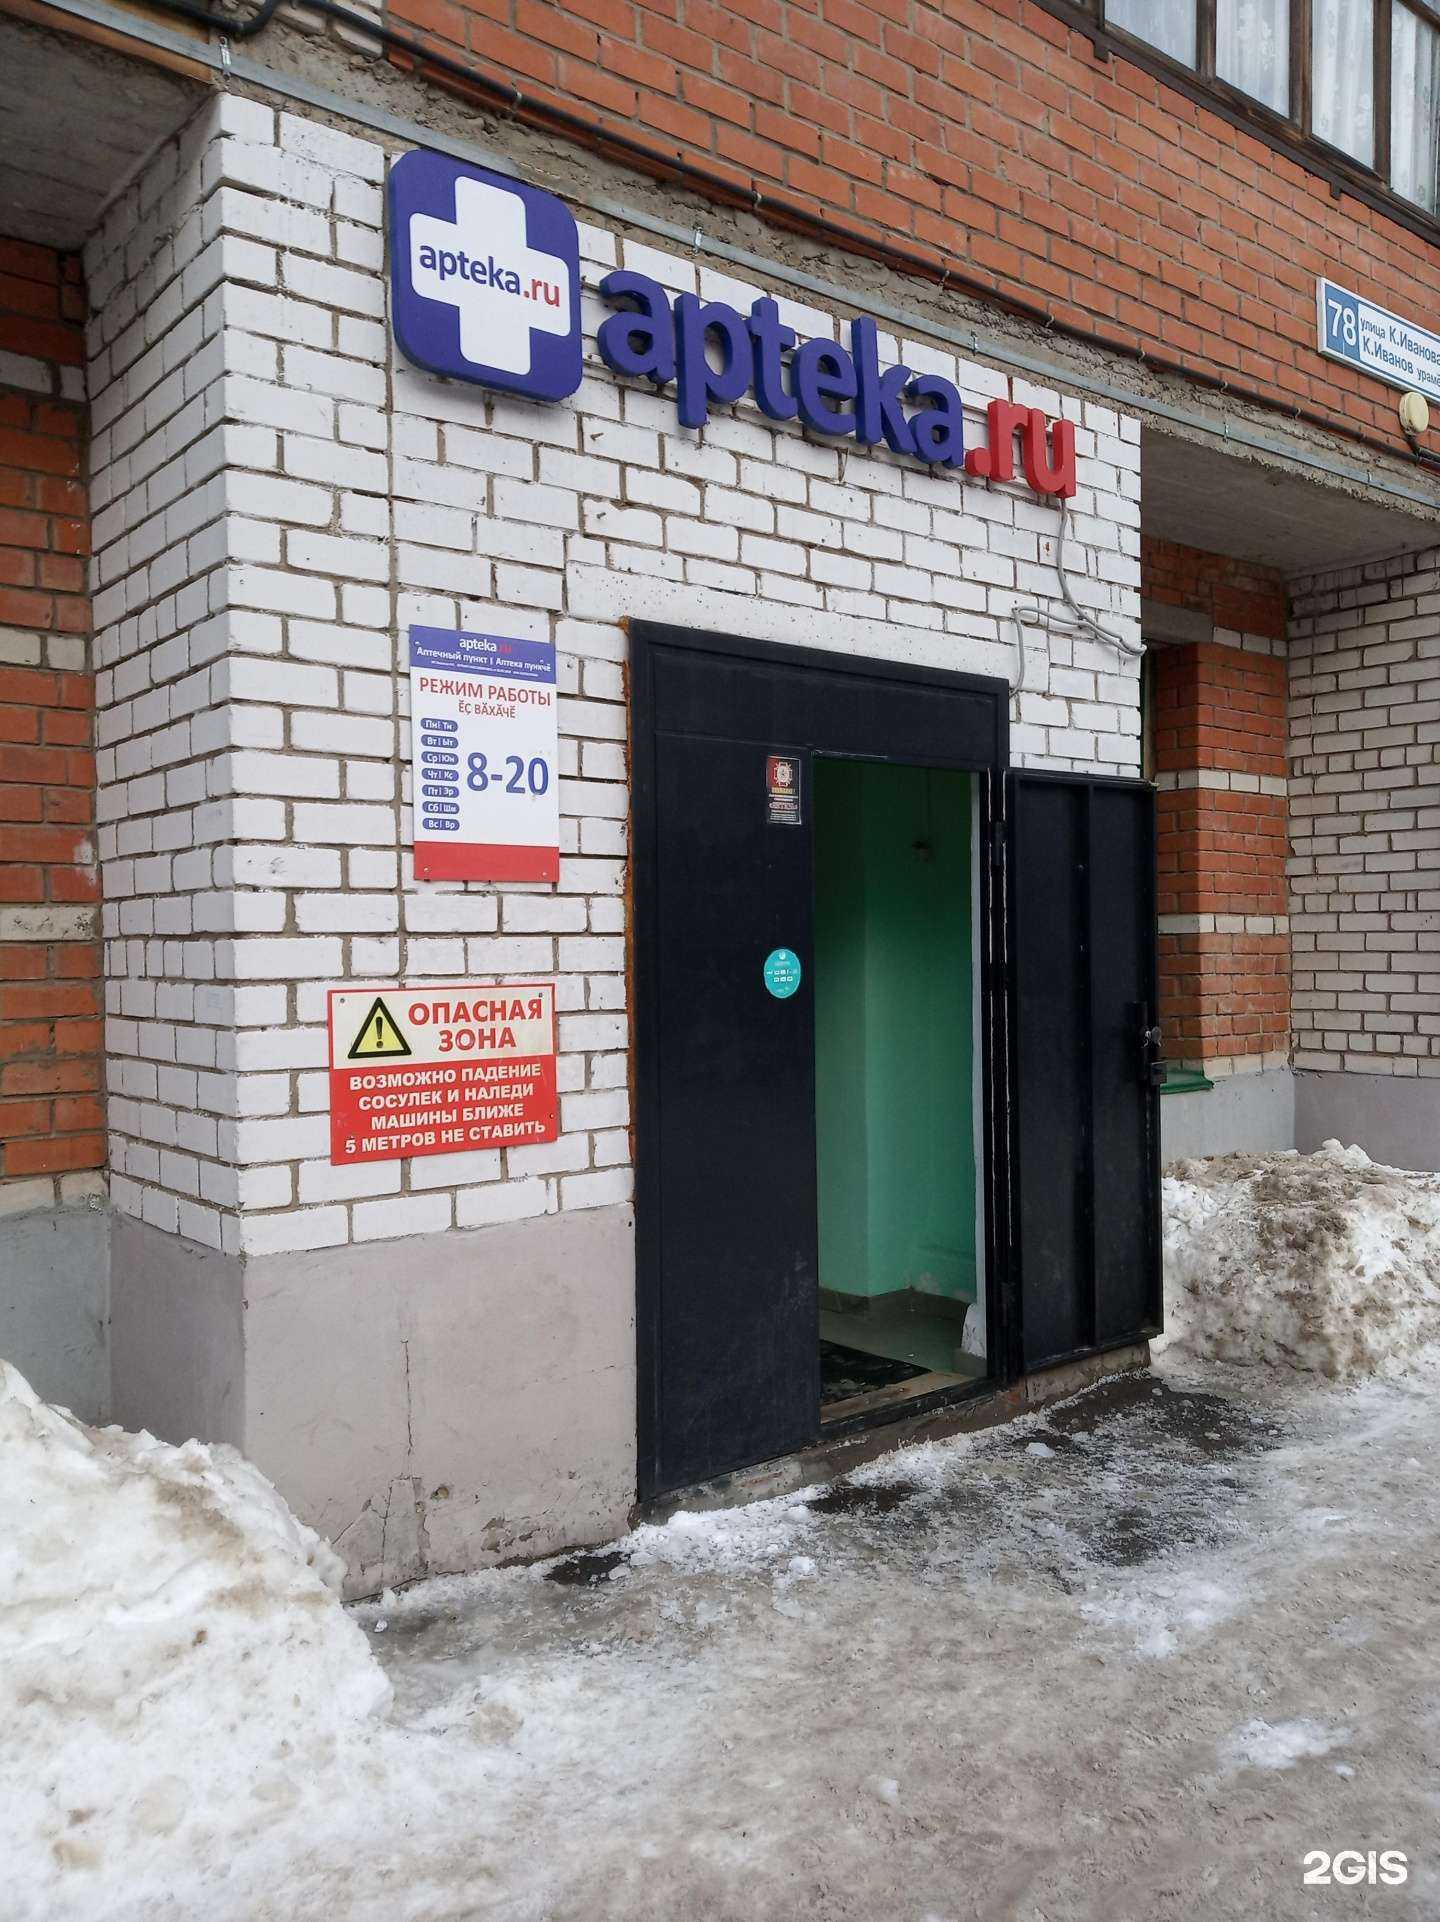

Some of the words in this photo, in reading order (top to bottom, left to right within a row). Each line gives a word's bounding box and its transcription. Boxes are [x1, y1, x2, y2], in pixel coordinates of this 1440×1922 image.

[420, 245, 559, 306] apteka.ru
[1327, 298, 1358, 346] 78
[1360, 317, 1386, 339] улица
[1363, 335, 1414, 374] К.Иванов
[597, 270, 1077, 498] apteka.ru
[416, 646, 461, 660] Аптечный
[463, 654, 488, 664] пункт
[495, 657, 523, 668] Аптека
[419, 677, 483, 698] РЕЖИМ
[488, 685, 551, 706] РАБОТЫ
[467, 752, 549, 796] 8-20
[408, 998, 543, 1026] ОПАСНАЯ
[438, 1027, 517, 1052] ЗОНА
[349, 1069, 456, 1091] ВОЗМОЖНО
[461, 1063, 541, 1083] ПАДЕНИЕ
[358, 1091, 442, 1111] СОСУЛЕК
[447, 1089, 459, 1103] И
[464, 1083, 534, 1101] НАЛЕДИ
[371, 1109, 457, 1131] МАШИНЫ
[462, 1103, 525, 1121] БЛИЖЕ
[344, 1140, 356, 1154] 5
[361, 1131, 436, 1153] МЕТРОВ
[441, 1128, 464, 1143] НЕ
[469, 1120, 546, 1140] СТАВИТЬ
